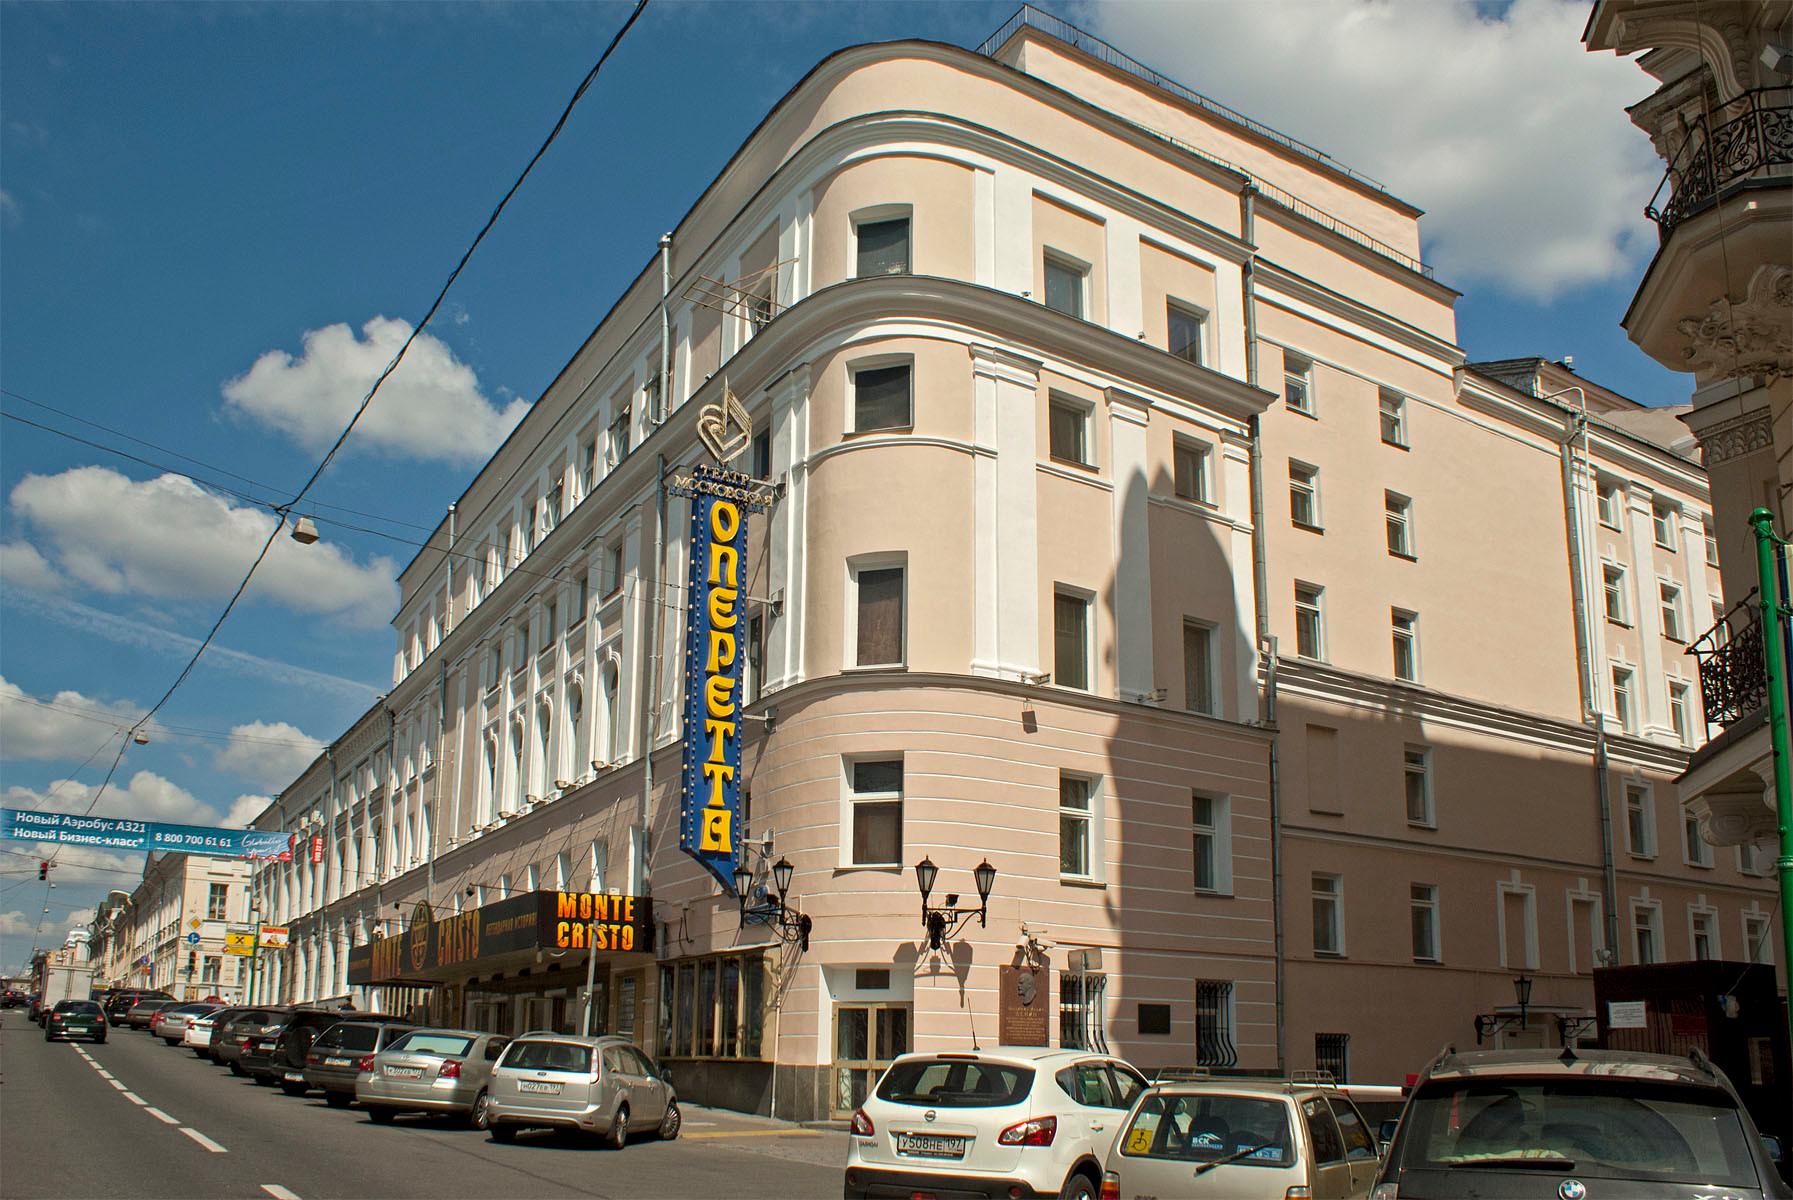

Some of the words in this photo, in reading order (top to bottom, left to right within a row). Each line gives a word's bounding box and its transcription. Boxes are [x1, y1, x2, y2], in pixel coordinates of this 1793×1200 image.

[700, 463, 751, 484] ТЕАТР
[674, 475, 773, 506] МОСКОВСКАЯ
[701, 499, 740, 855] ОПЕРЕТТА
[14, 828, 56, 840] Новый
[16, 812, 59, 825] Новый
[62, 816, 114, 831] Аэробус
[154, 832, 162, 841] 8
[164, 834, 182, 843] 800
[185, 835, 203, 845] 700
[205, 837, 216, 846] 61
[219, 838, 231, 847] 61
[557, 892, 635, 921] MONTE
[438, 909, 480, 967] CRISTO
[557, 921, 634, 951] CRISTO
[945, 1138, 961, 1150] 197
